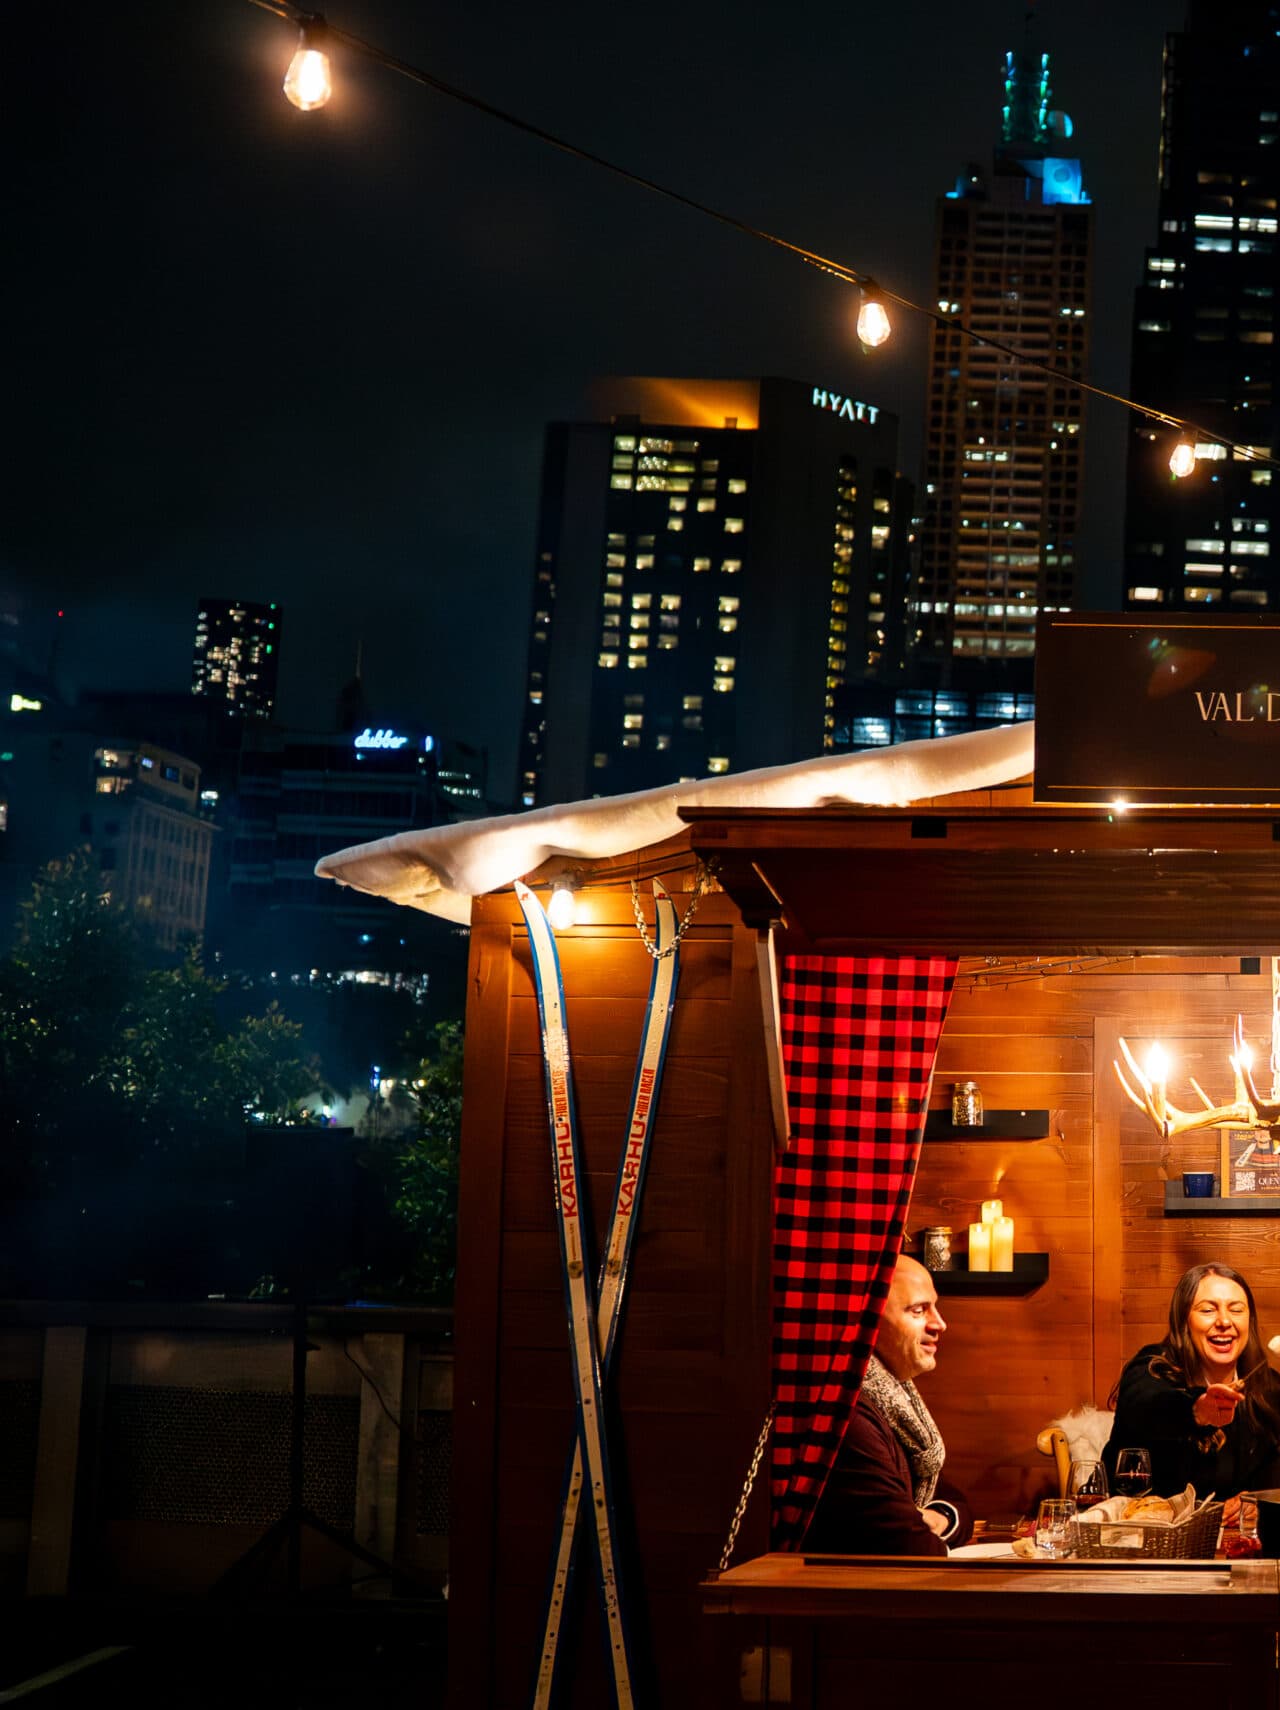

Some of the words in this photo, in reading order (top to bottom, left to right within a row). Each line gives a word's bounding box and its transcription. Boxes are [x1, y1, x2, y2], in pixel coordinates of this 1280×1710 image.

[812, 387, 880, 425] HYATT
[1195, 691, 1255, 723] VAL
[354, 728, 408, 749] dubber
[556, 1122, 578, 1218] KARHU
[616, 1120, 647, 1217] KARHU
